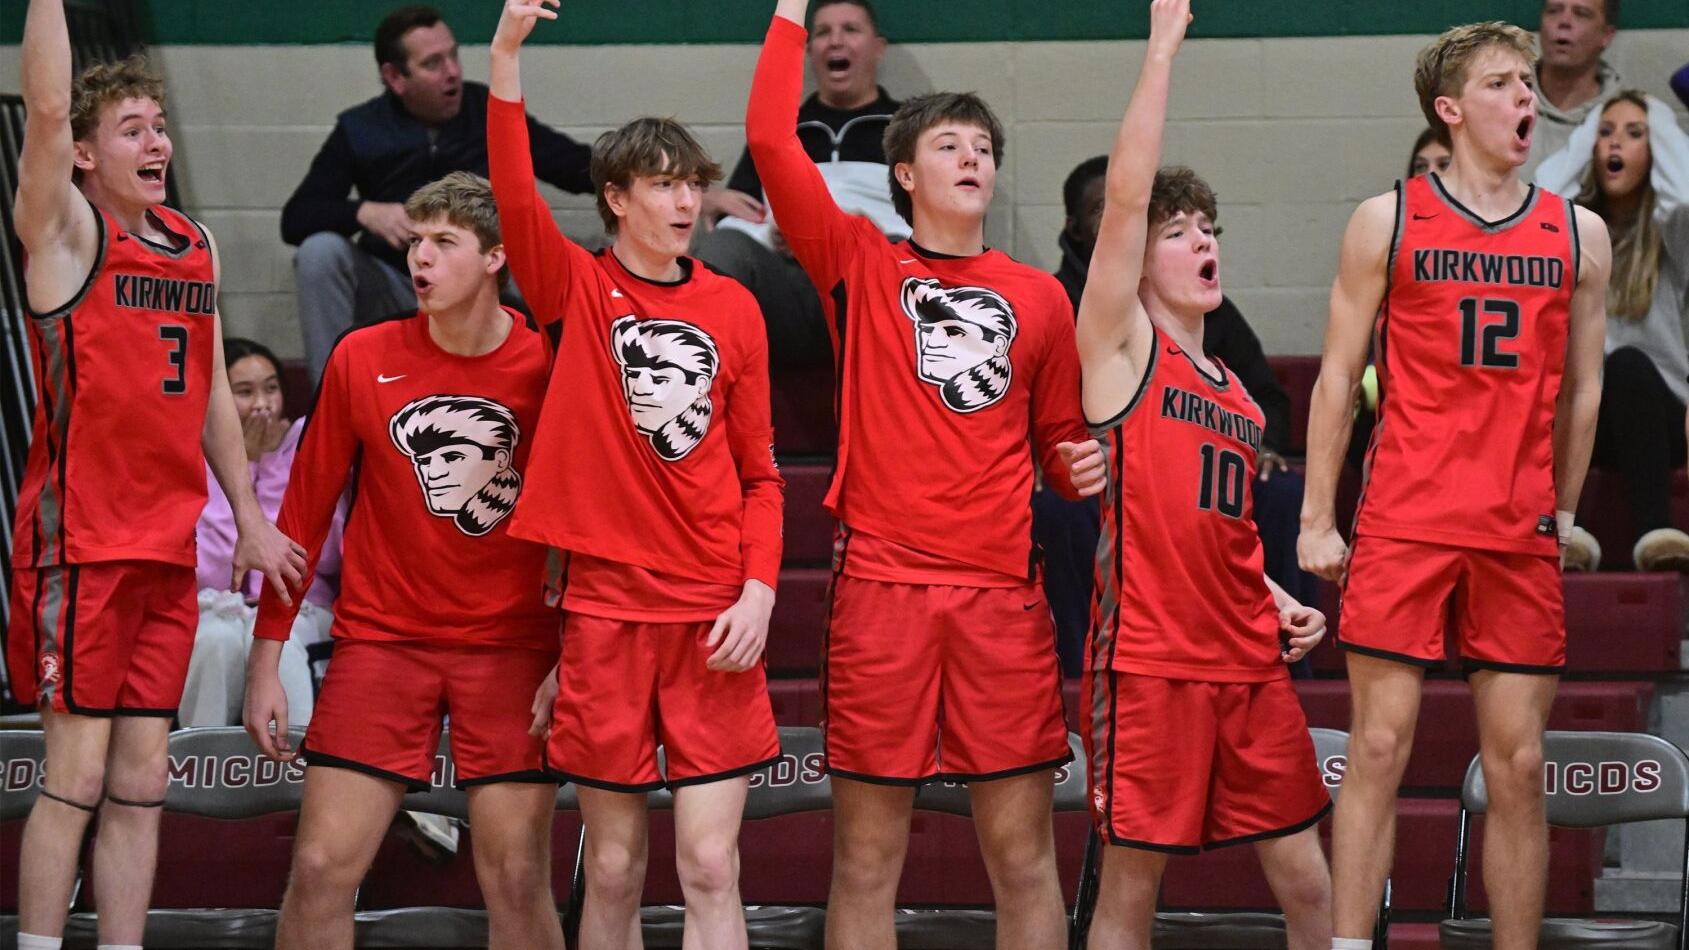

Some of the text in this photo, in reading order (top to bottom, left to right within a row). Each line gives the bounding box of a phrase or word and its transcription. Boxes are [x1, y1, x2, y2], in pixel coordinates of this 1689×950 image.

[114, 273, 215, 315] KIRKWOO
[1413, 248, 1564, 289] KIRKWOOD
[158, 325, 189, 394] 3
[1459, 297, 1520, 369] 12
[1198, 442, 1246, 520] 10
[1544, 759, 1662, 796] ICDS
